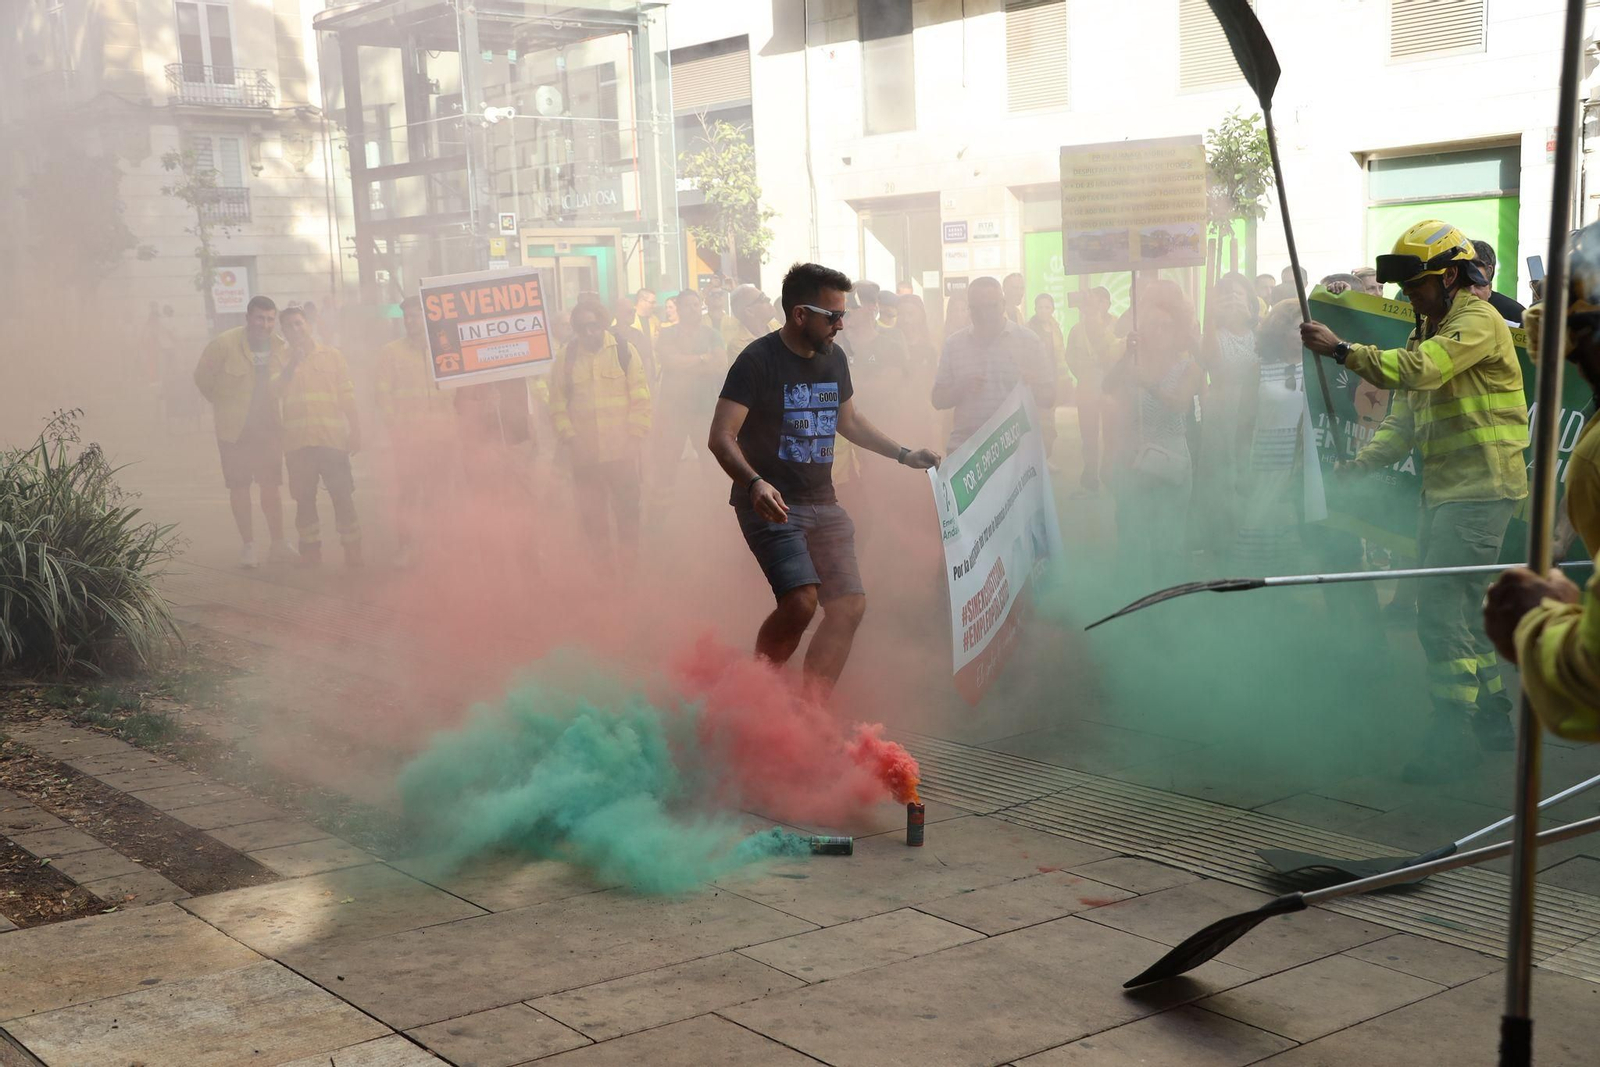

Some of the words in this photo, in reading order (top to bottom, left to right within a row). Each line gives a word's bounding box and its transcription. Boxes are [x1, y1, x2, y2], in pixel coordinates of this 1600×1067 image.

[425, 292, 459, 322] SE
[460, 281, 542, 316] VENDE
[1382, 303, 1400, 315] 112
[459, 316, 544, 341] INFOCA
[819, 392, 838, 402] GOOD
[794, 419, 809, 430] BAD
[962, 470, 978, 495] POR
[976, 463, 984, 481] EL
[983, 443, 1000, 472] EMPLEO
[1000, 422, 1021, 451] PÚBLICO
[953, 563, 964, 581] Por
[963, 559, 970, 574] la
